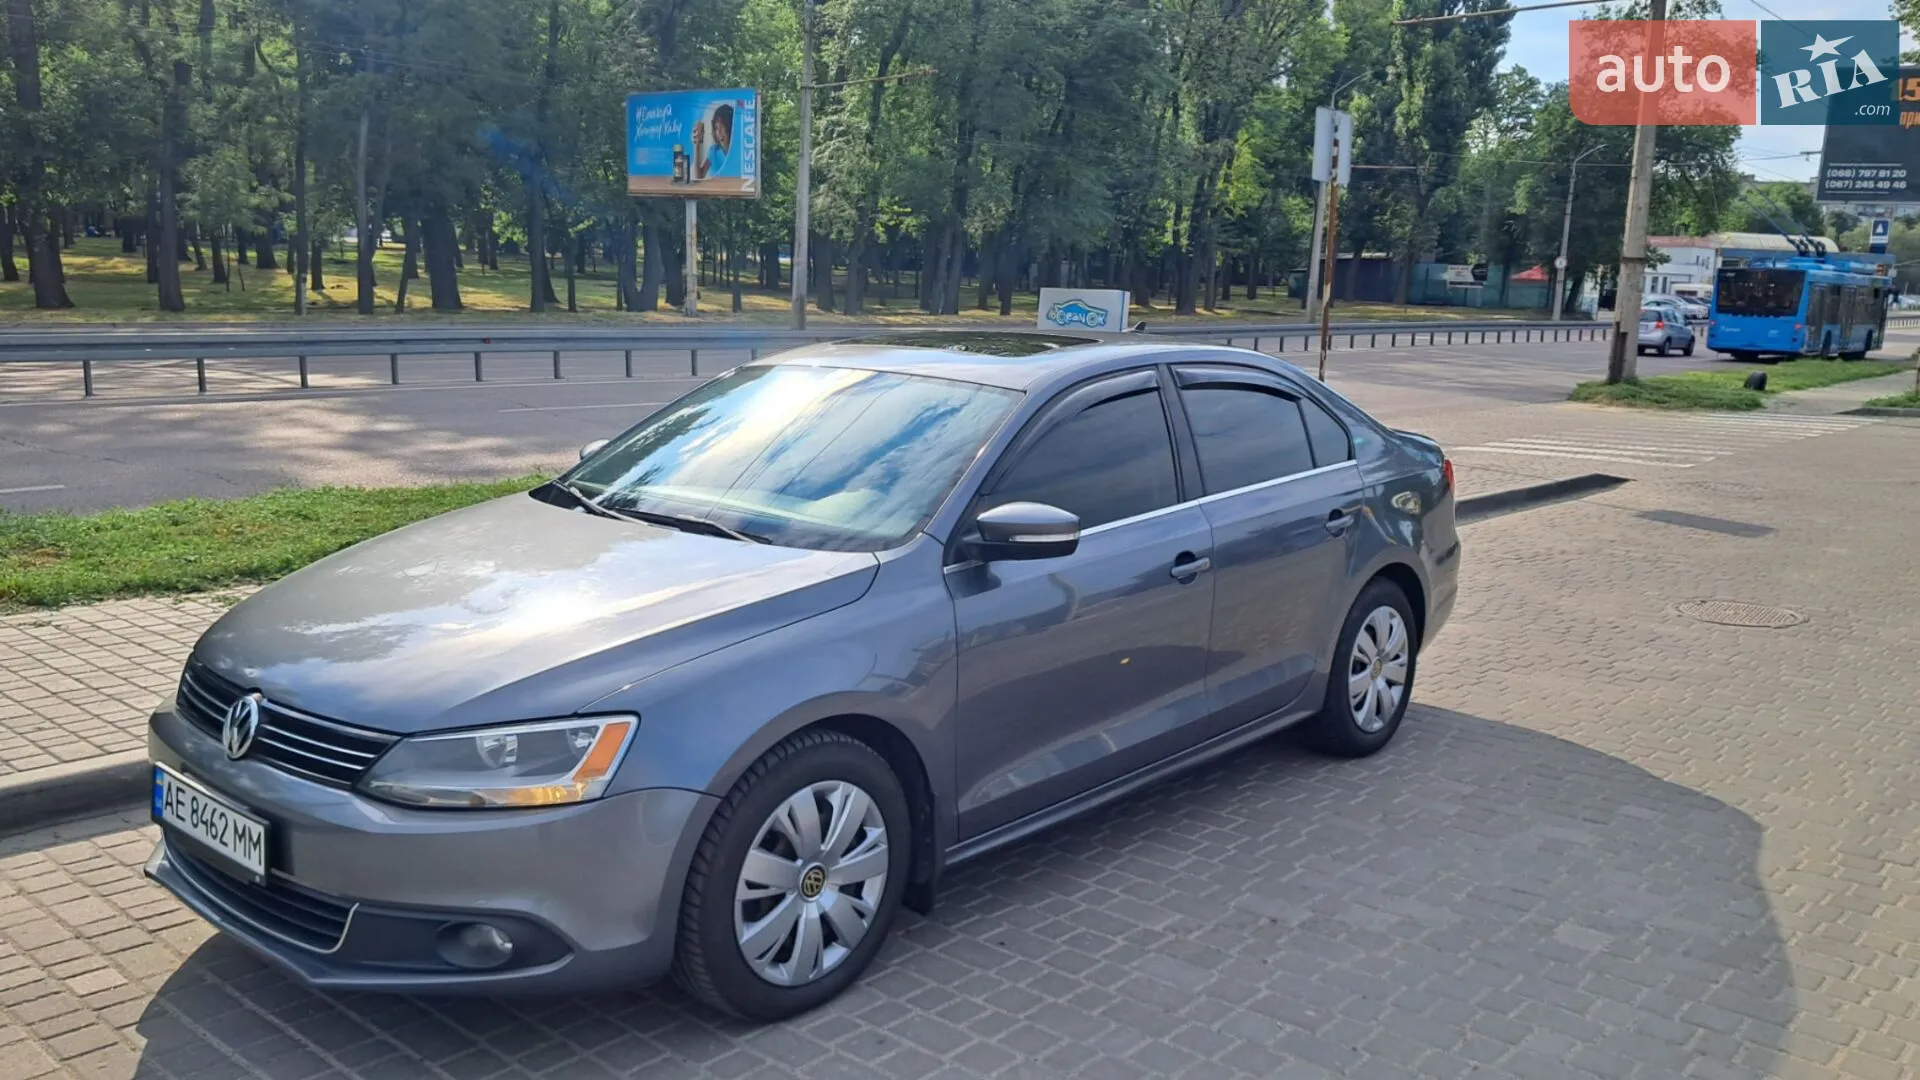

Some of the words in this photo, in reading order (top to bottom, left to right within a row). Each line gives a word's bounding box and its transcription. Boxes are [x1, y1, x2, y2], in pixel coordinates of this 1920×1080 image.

[1858, 169, 1877, 178] 797
[1891, 169, 1907, 178] 20
[164, 781, 186, 822] AE
[190, 796, 229, 848] 8462
[233, 819, 262, 867] MM
